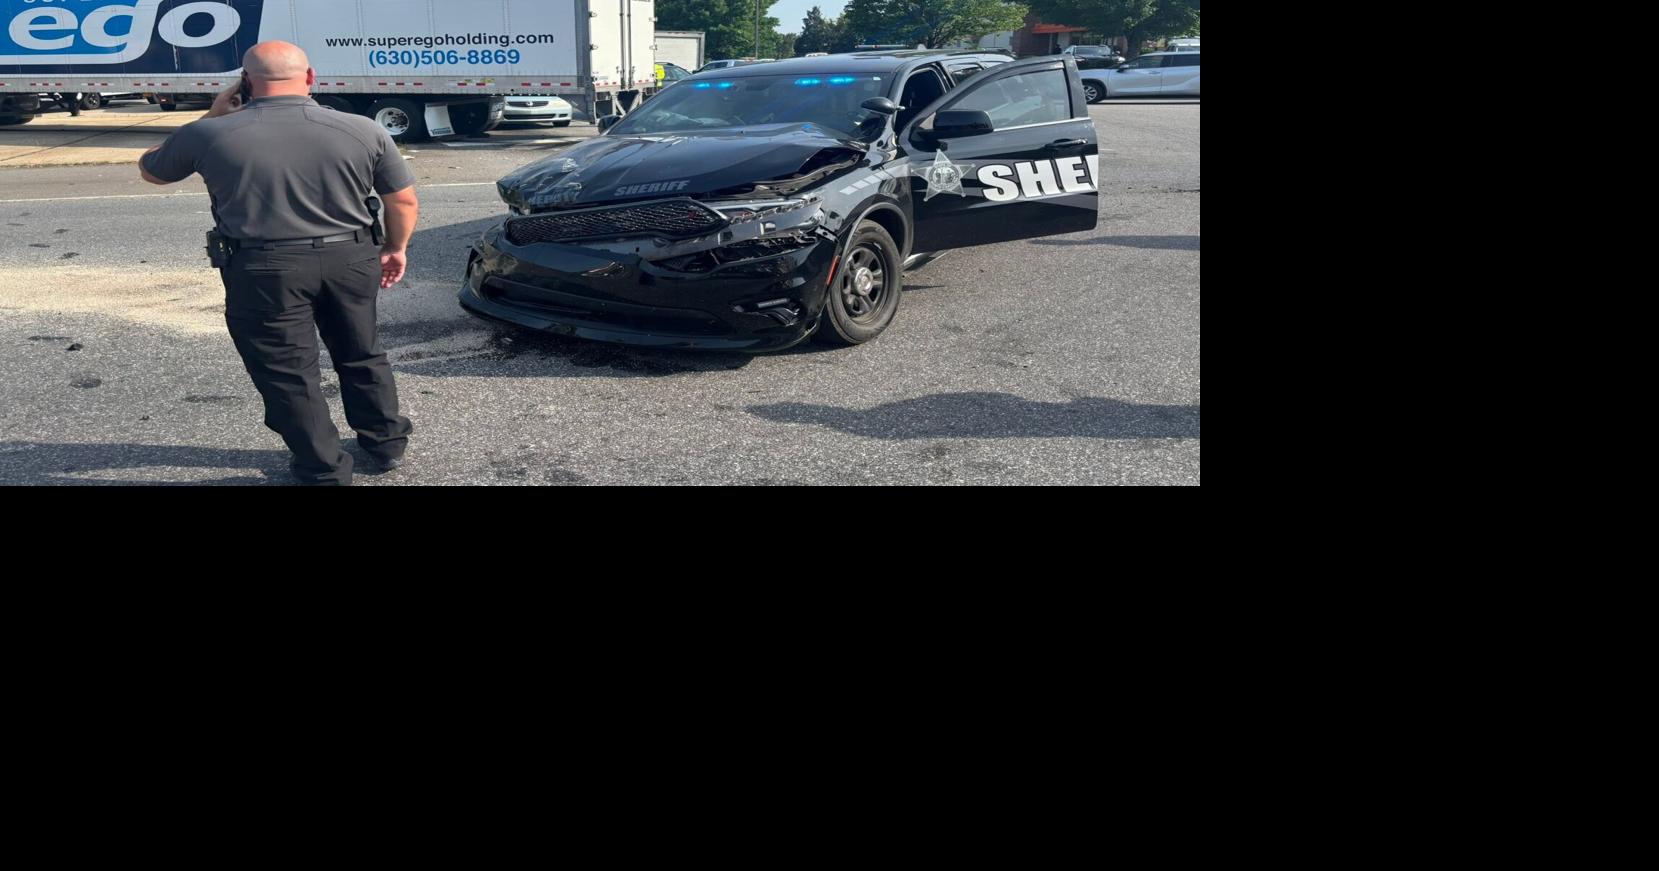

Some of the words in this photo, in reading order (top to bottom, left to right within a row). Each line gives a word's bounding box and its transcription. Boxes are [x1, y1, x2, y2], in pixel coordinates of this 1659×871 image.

[8, 0, 241, 64] ego
[325, 33, 554, 49] www.superegoholding.com
[368, 48, 520, 69] (630)506-8869
[614, 180, 690, 196] SHERIFF
